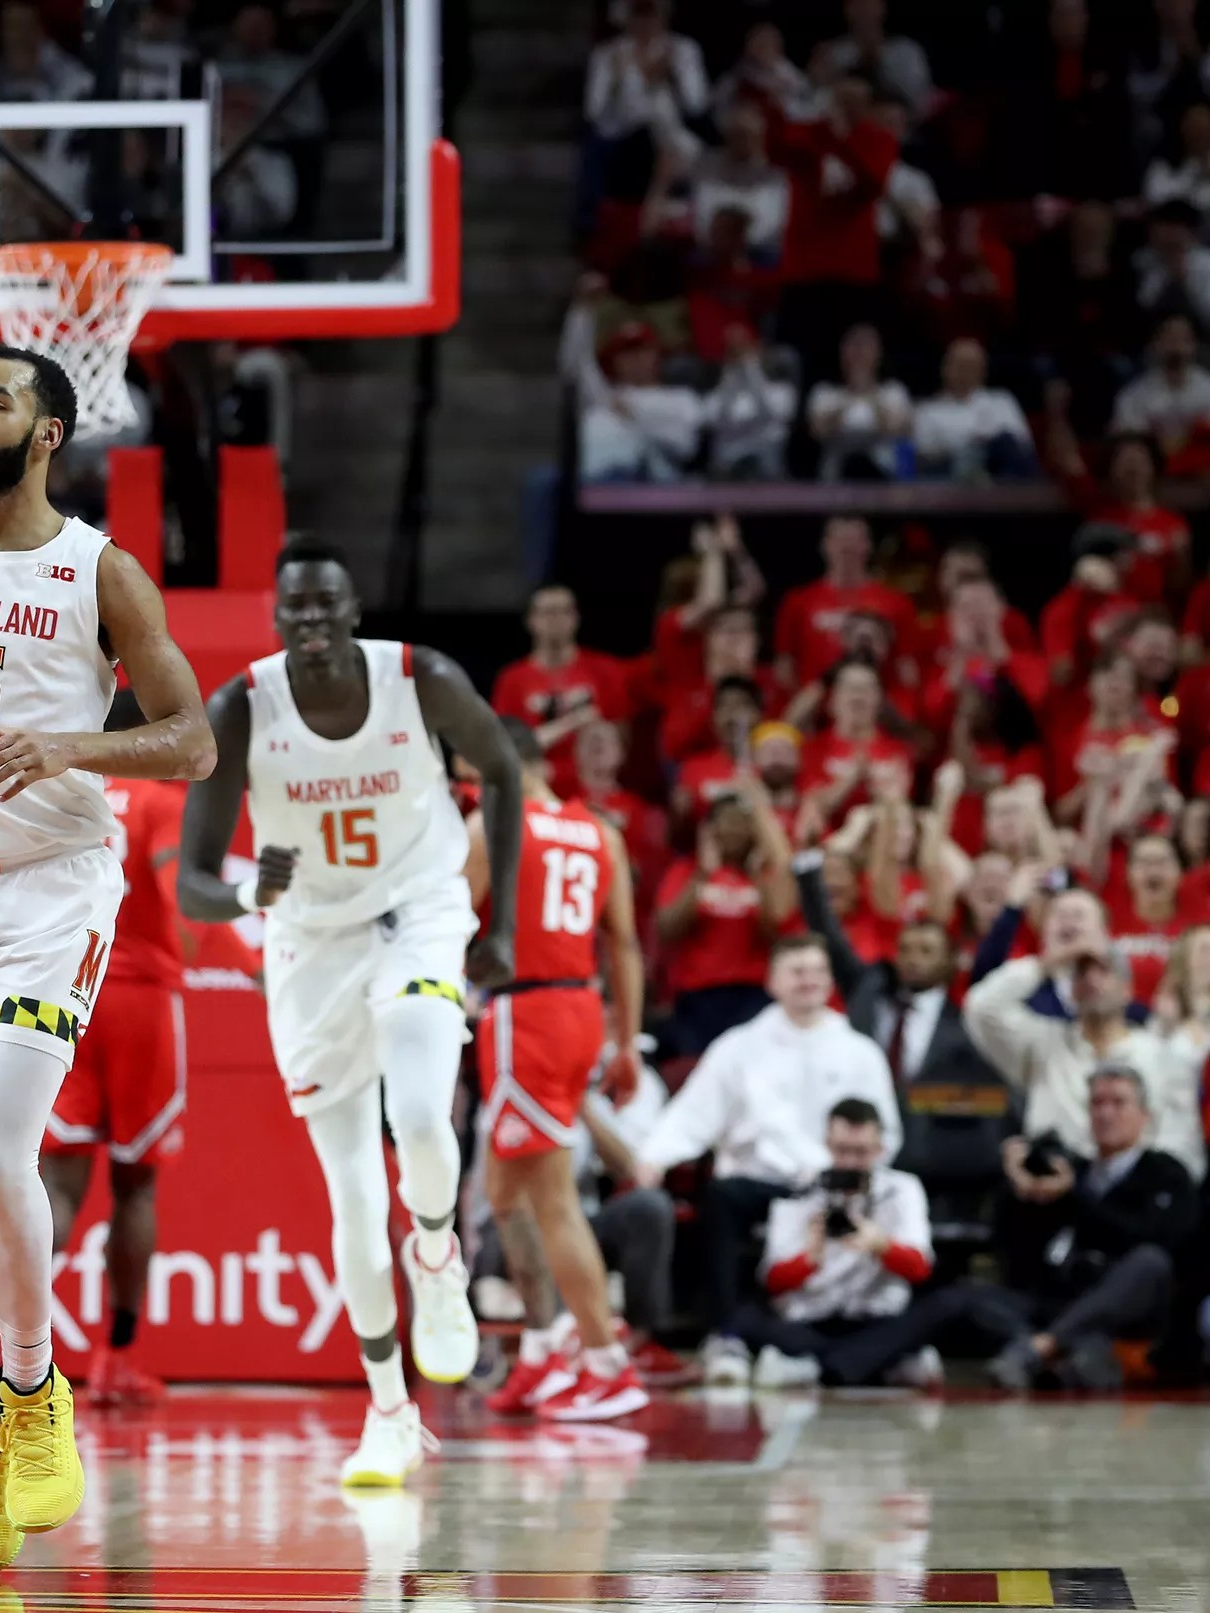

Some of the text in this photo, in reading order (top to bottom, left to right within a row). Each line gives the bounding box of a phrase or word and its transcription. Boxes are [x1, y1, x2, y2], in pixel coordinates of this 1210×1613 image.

[285, 769, 400, 804] MARYLAND
[320, 807, 378, 868] 15
[541, 847, 599, 936] 13
[71, 928, 108, 1003] M
[52, 1220, 345, 1353] xfnity
